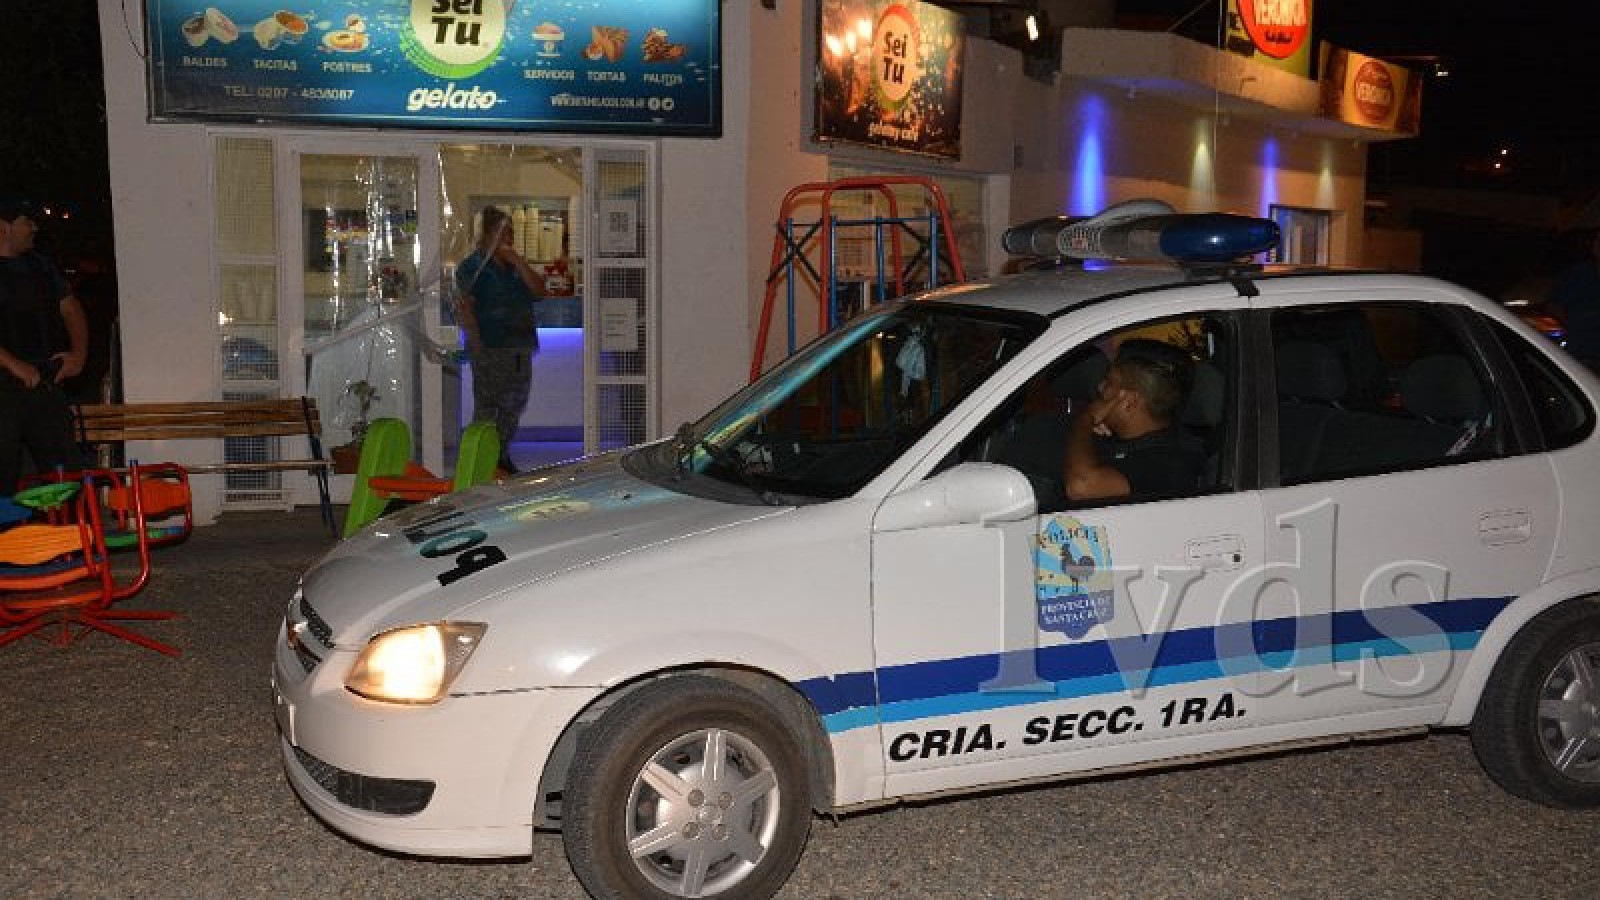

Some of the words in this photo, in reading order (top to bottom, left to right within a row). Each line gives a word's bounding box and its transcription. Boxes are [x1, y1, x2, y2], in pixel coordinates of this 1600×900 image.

[431, 16, 482, 46] Tu
[884, 31, 908, 58] Sei
[182, 56, 227, 67] BALDES
[254, 59, 297, 71] TACITAS
[322, 61, 372, 73] POSTRES
[884, 58, 905, 85] Tu
[586, 71, 627, 82] TORTAS
[644, 73, 682, 86] PALITOS
[406, 82, 497, 111] gelato
[890, 724, 1004, 760] CRIA.
[1024, 706, 1142, 744] SECC.
[1162, 694, 1244, 726] 1RA.
